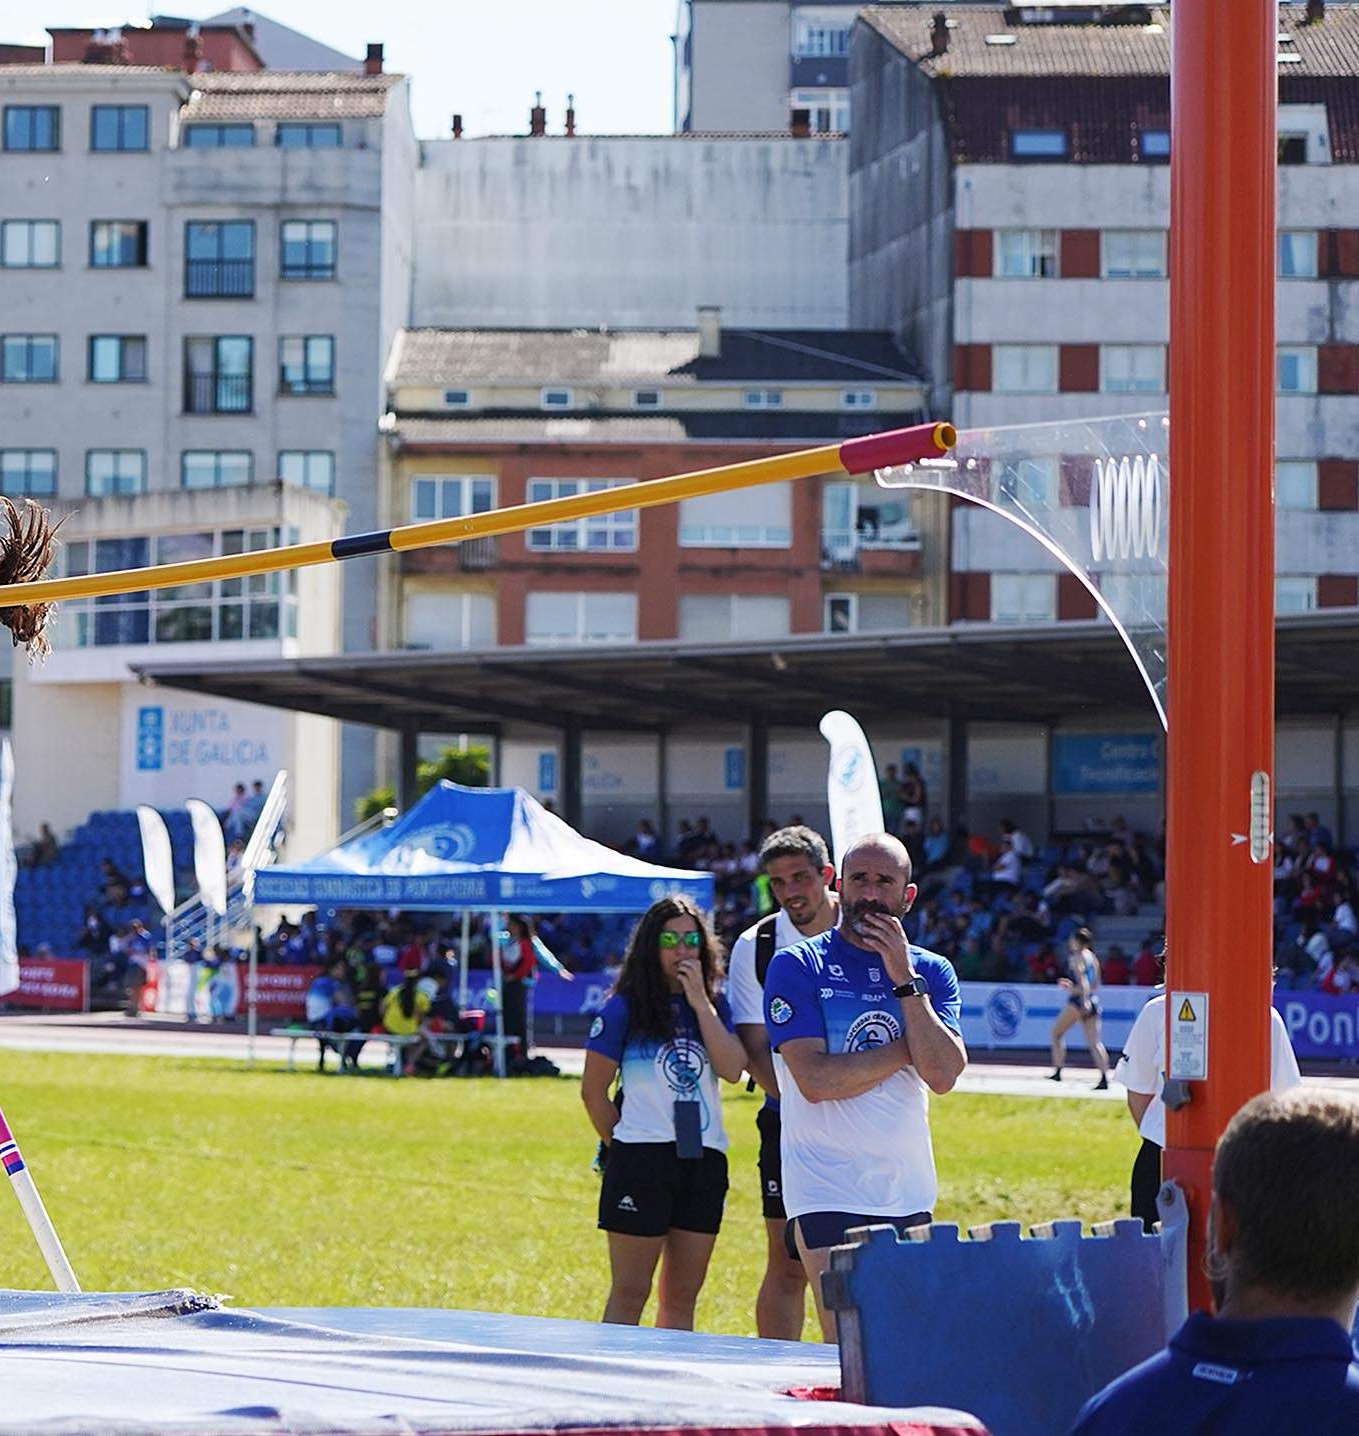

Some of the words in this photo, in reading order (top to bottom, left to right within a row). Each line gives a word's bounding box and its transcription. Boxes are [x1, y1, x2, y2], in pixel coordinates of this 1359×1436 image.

[169, 708, 232, 733] XUNTA
[169, 739, 192, 765] DE
[196, 738, 270, 766] GALICIA
[1286, 1002, 1359, 1046] Pon
